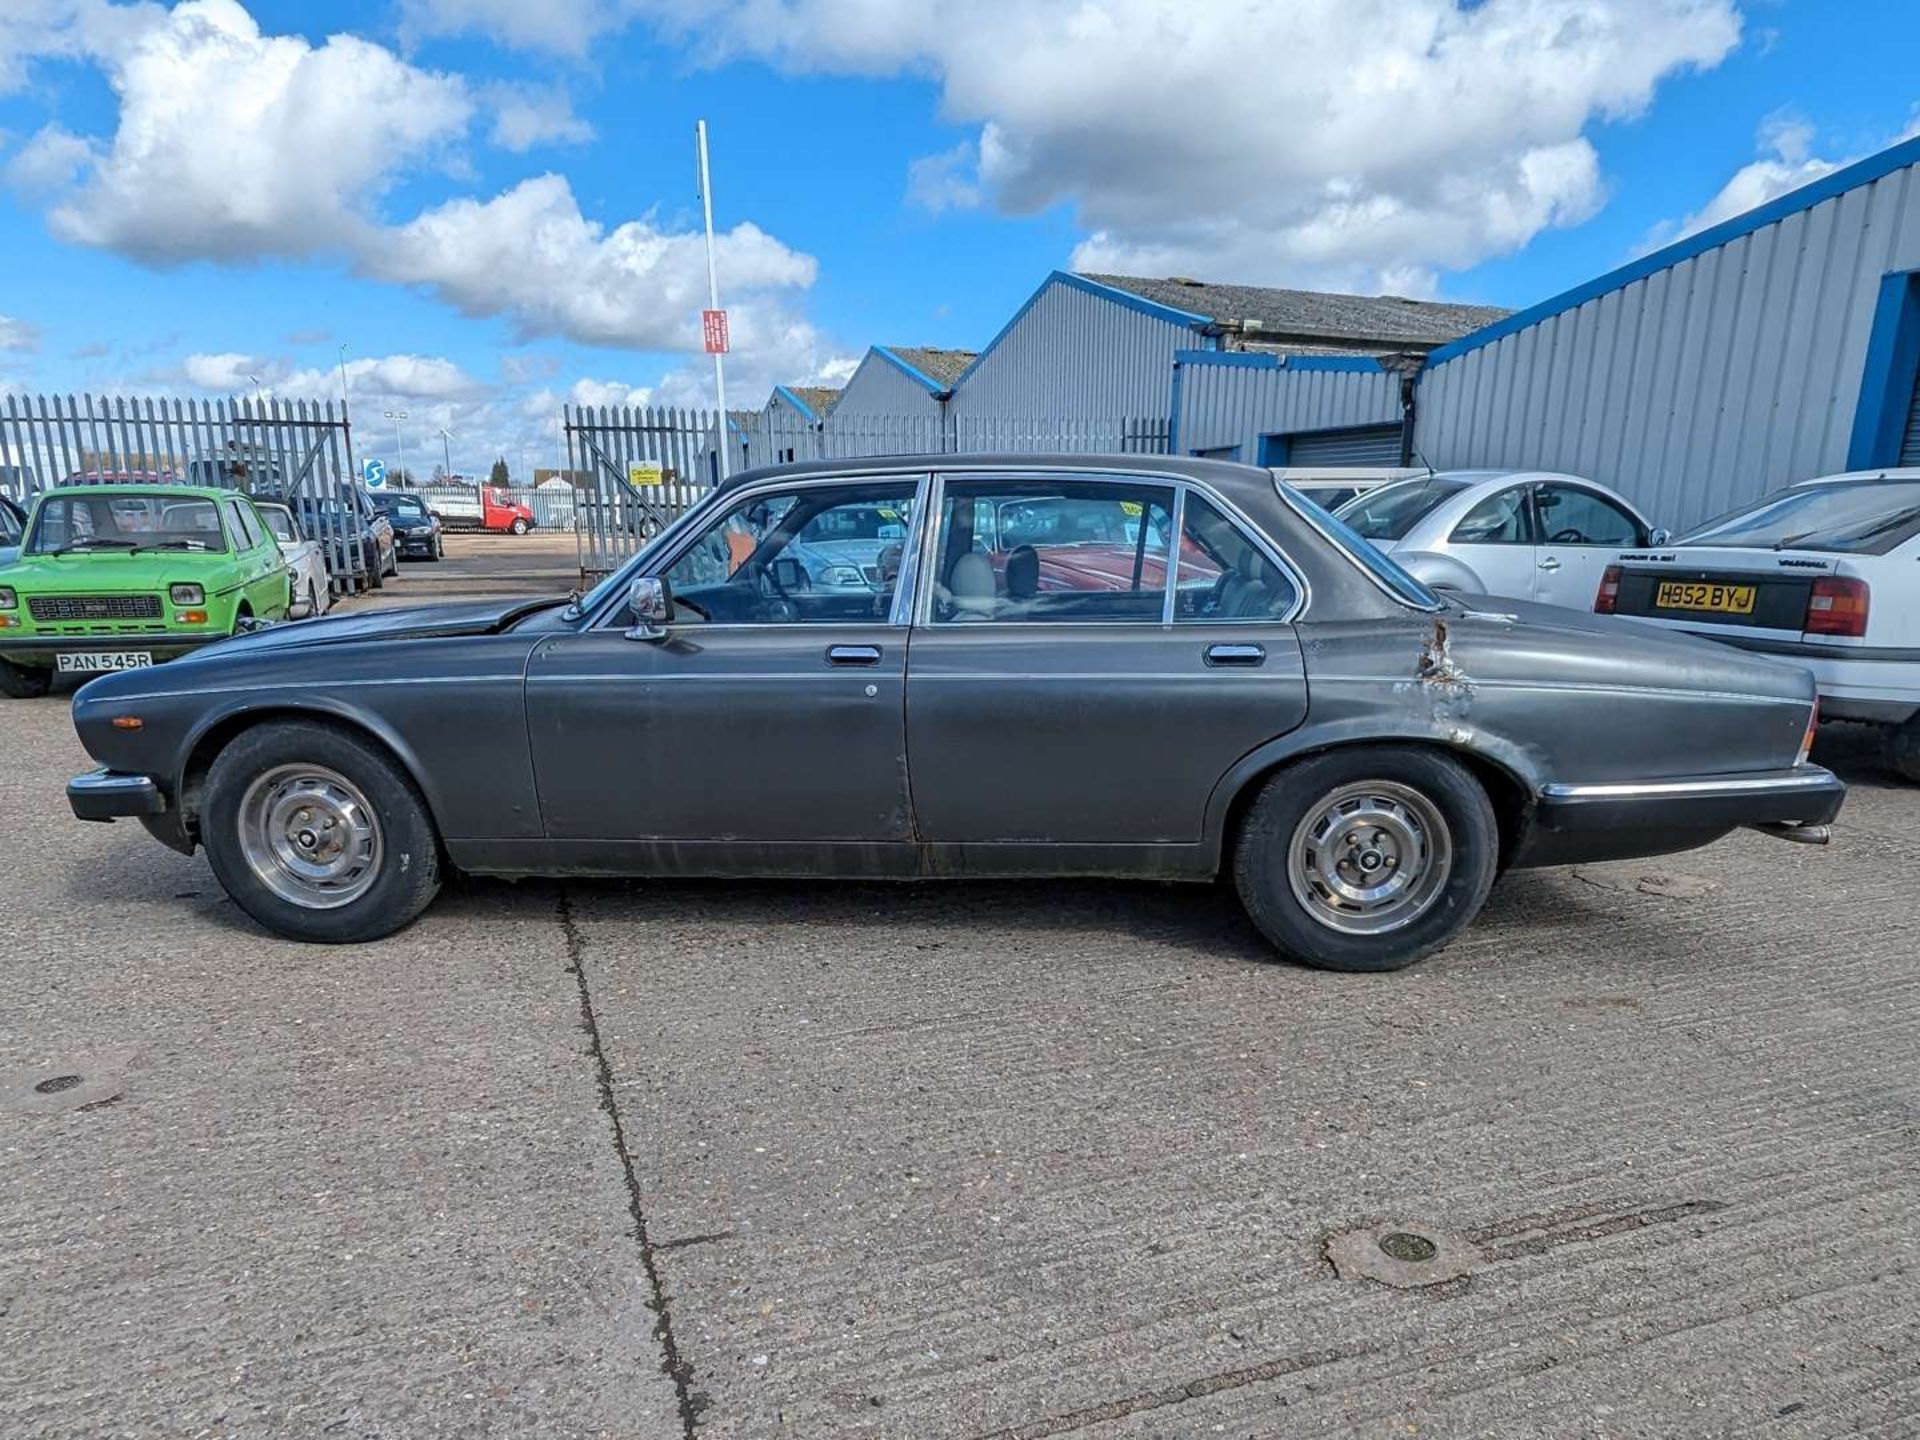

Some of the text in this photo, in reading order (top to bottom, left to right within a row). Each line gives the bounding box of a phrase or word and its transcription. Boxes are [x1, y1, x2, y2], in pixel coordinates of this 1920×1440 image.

[1660, 584, 1752, 608] H952 BYJ
[60, 654, 148, 669] PAN 545R
